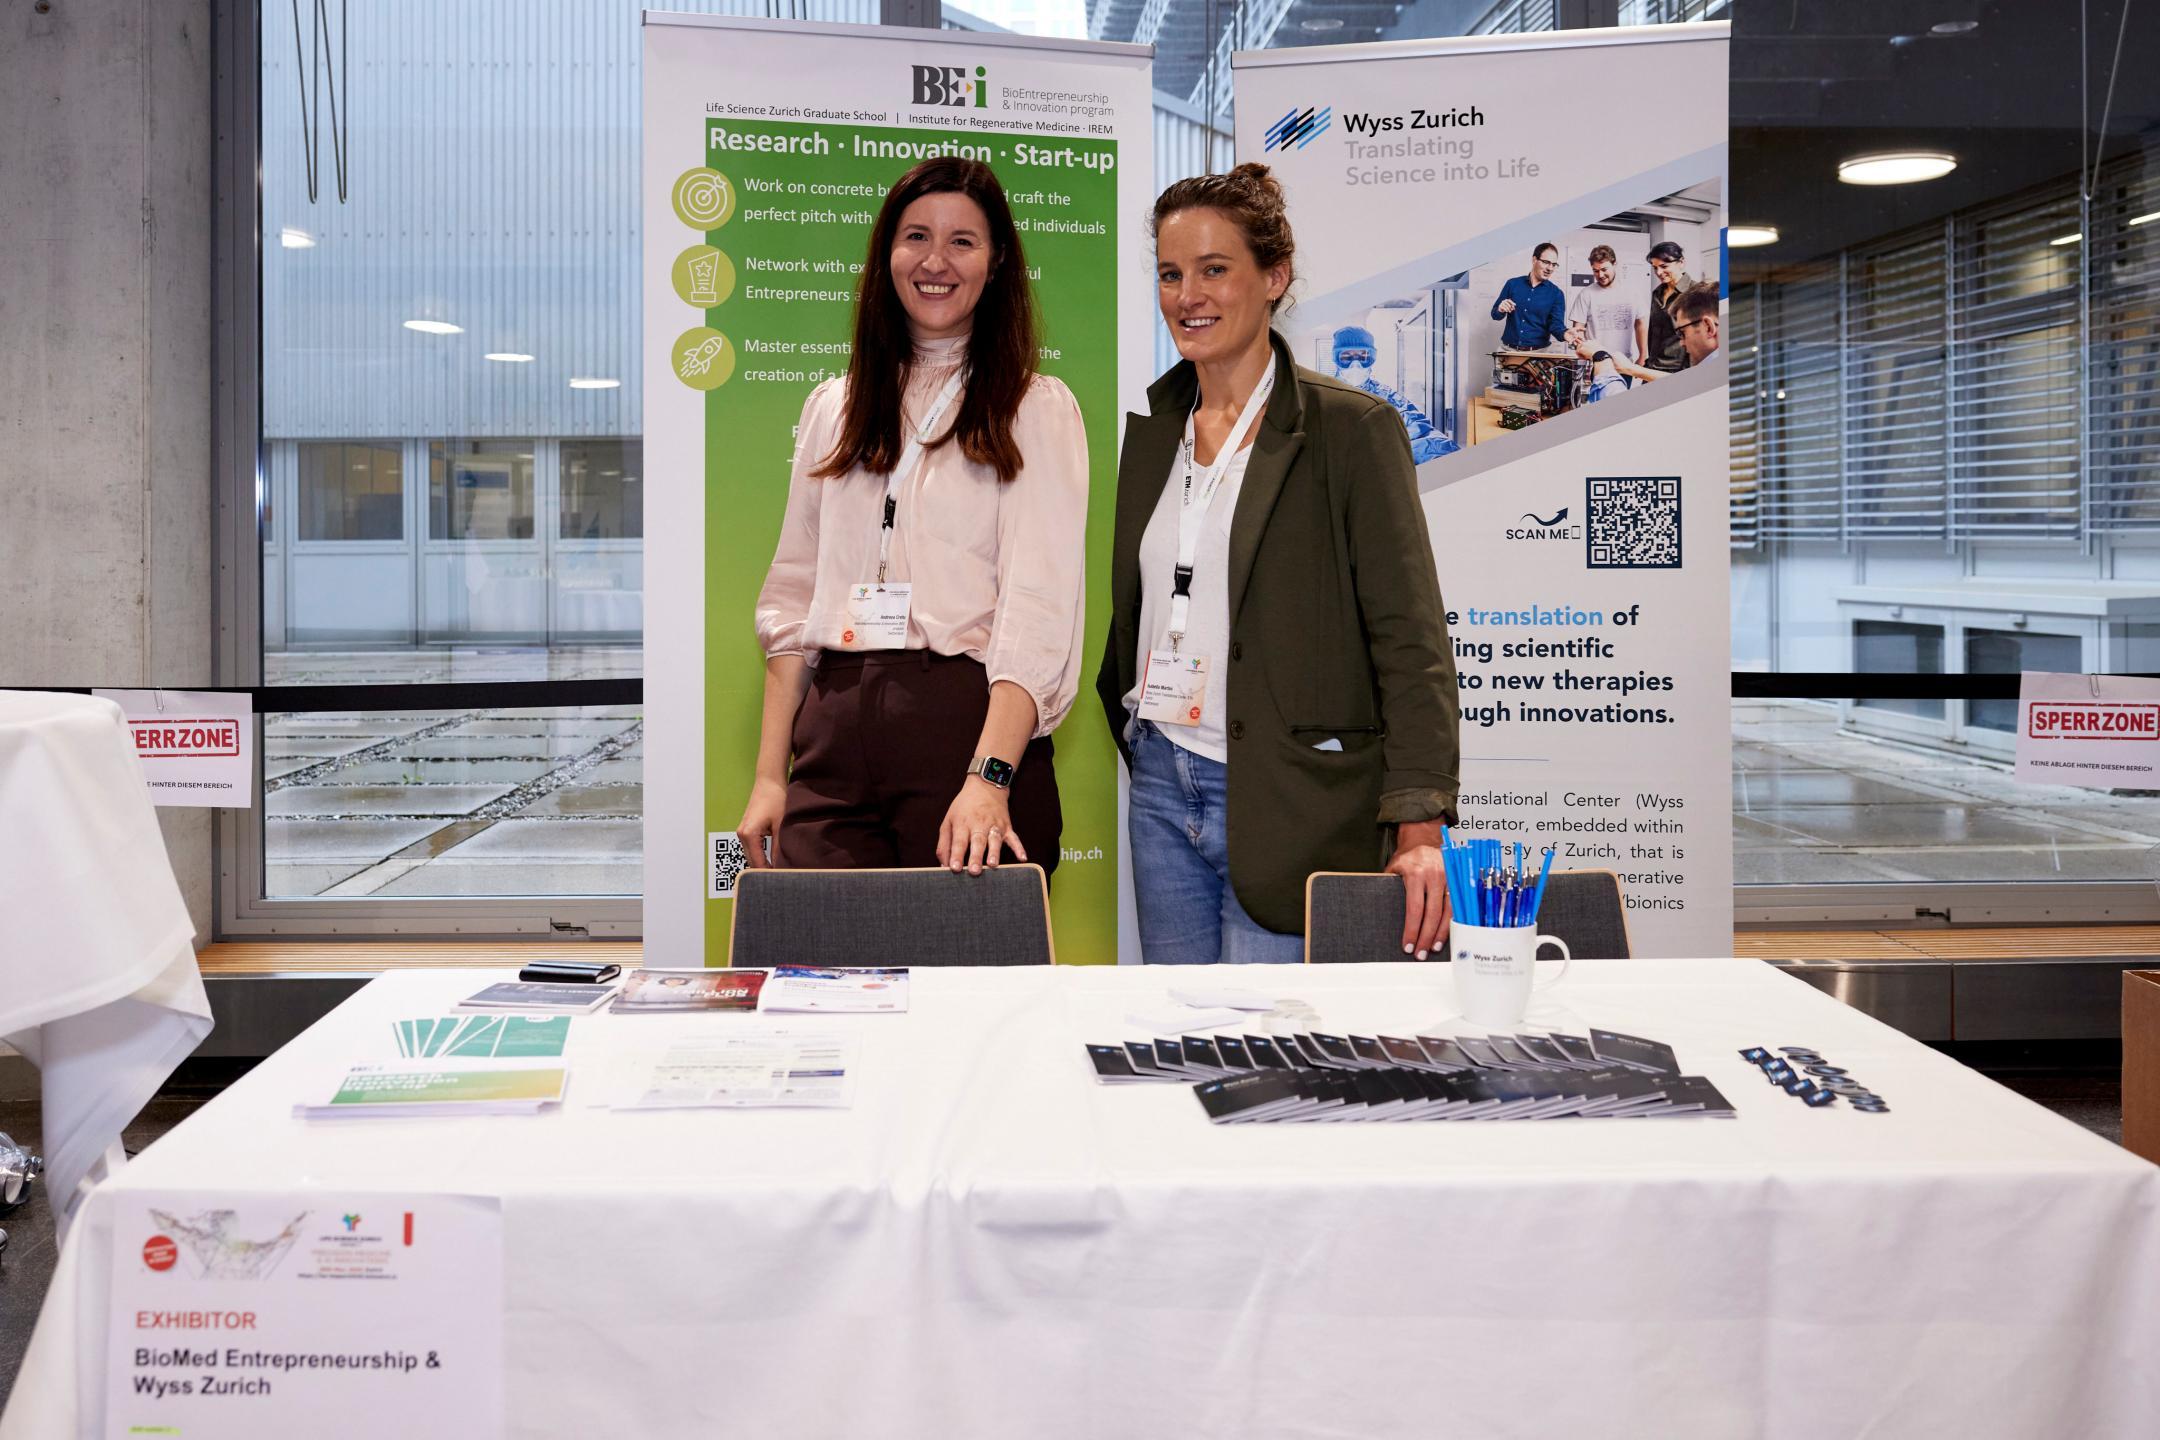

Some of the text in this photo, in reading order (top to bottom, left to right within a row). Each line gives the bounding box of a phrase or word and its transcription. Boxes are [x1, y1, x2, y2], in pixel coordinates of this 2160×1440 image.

[1002, 87, 1109, 105] BioEntrepreneurship
[706, 102, 887, 122] Life Science Zurich Graduate School
[1002, 99, 1114, 118] & Innovation program
[909, 114, 1113, 134] Institute for Regenerative Medicine IREM
[1343, 105, 1485, 137] Wyss Zurich
[710, 127, 1115, 175] Research Innovation Start-up
[1345, 136, 1474, 160] Translating
[1346, 158, 1541, 186] Science into Life
[744, 178, 783, 193] Work
[787, 183, 806, 194] on
[810, 184, 873, 197] concrete
[1013, 190, 1044, 204] craft
[1048, 192, 1071, 206] the
[744, 207, 873, 225] perfect pitch with
[1033, 218, 1106, 235] individuals
[746, 257, 809, 272] Network
[813, 259, 845, 273] with
[745, 286, 850, 302] Entrepreneurs
[744, 339, 796, 353] Master
[1039, 346, 1061, 360] the
[744, 368, 804, 382] creation
[809, 369, 824, 382] of
[1505, 528, 1569, 540] SCAN ME
[1467, 605, 1604, 626] translation
[1612, 604, 1639, 626] of
[1502, 637, 1615, 659] scientific
[1492, 673, 1545, 690] new
[1553, 669, 1674, 697] therapies
[1519, 702, 1675, 724] innovations.
[2035, 711, 2156, 732] SPERRZONE
[131, 728, 234, 749] ERRZONE
[2050, 761, 2075, 769] ABLAGE
[2076, 762, 2100, 770] HINTER
[2101, 763, 2125, 771] DIESEM
[1563, 791, 1621, 808] Center
[1636, 792, 1684, 813] (Wyss
[1535, 816, 1628, 834] embedded
[1633, 819, 1684, 834] within
[1565, 843, 1621, 860] Zurich,
[1630, 844, 1664, 859] that
[1672, 845, 1684, 860] is
[135, 1310, 257, 1330] EXHIBITOR
[135, 1348, 441, 1373] BioMed Entrepreneurship &
[133, 1376, 271, 1399] Wyss Zurich
